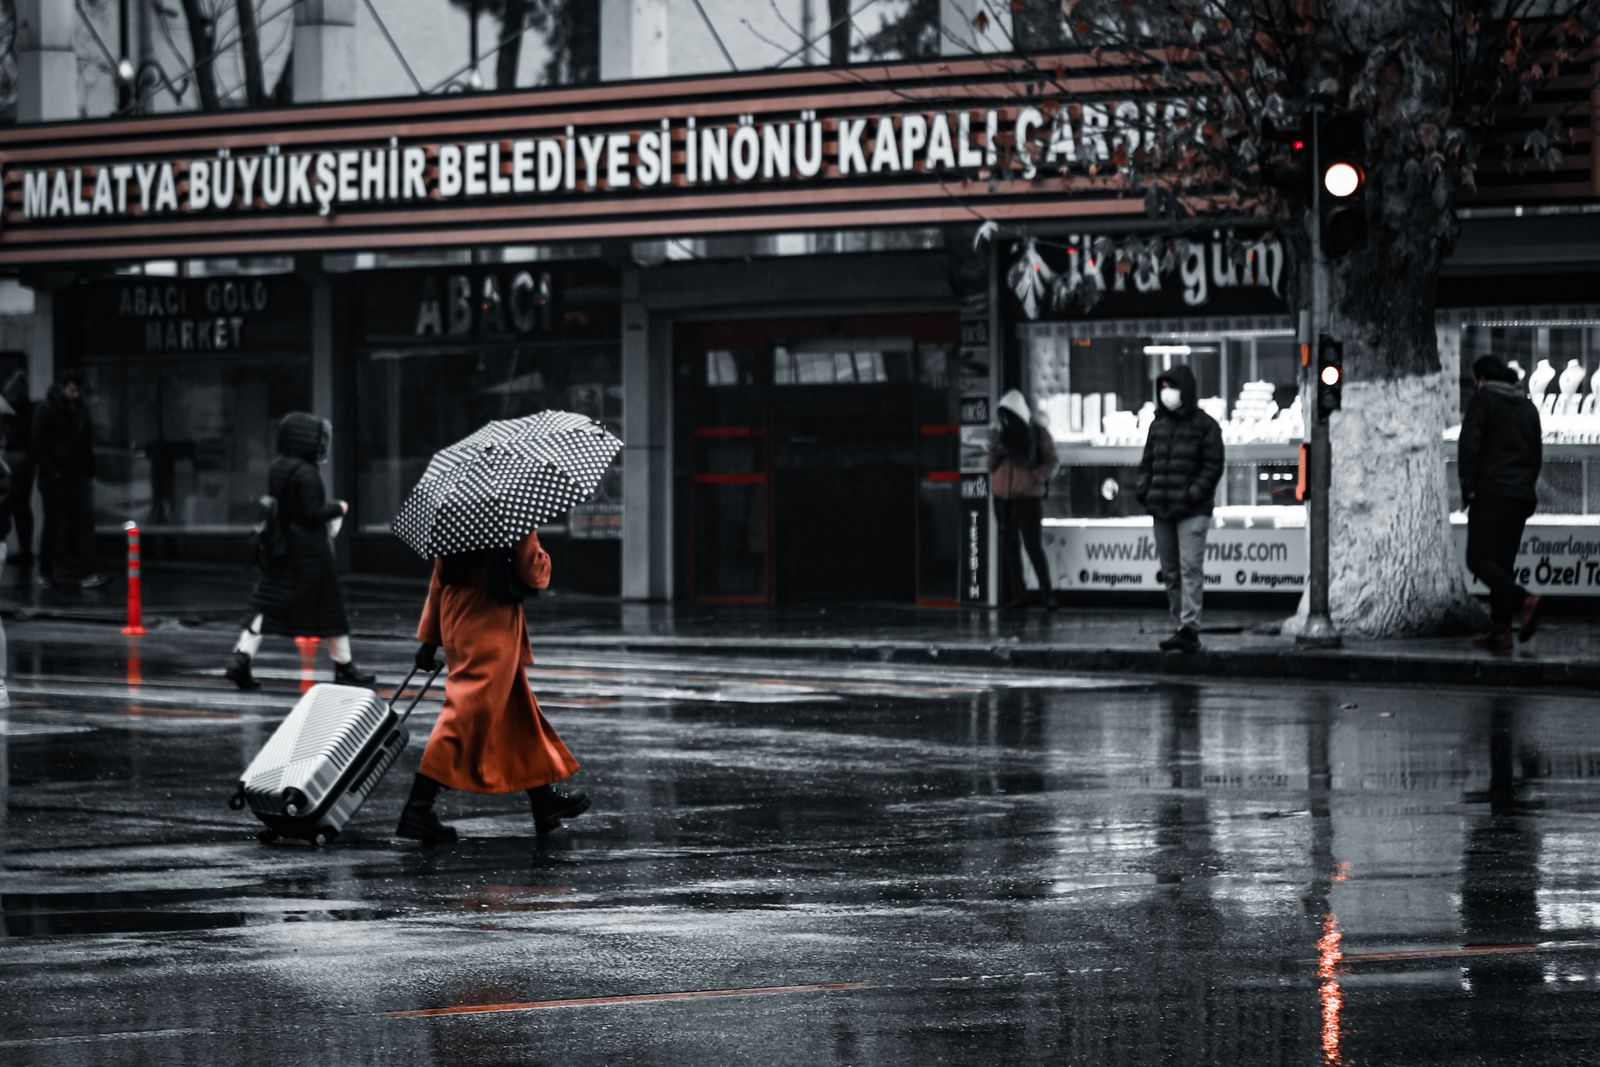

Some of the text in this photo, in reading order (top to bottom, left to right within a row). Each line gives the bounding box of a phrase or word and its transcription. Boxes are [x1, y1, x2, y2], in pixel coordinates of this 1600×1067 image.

[23, 162, 178, 218] MALATYA
[190, 136, 426, 216] BÜYÜKŞEHİR
[438, 117, 671, 197] BELEDİYESİ
[686, 110, 822, 183] İNÖNÜ
[838, 110, 997, 174] KAPALI
[118, 279, 268, 317] ABACI GOLD
[415, 271, 552, 336] ABACI
[145, 317, 243, 350] MARKET
[1086, 536, 1287, 562] www.ikmus.com
[1535, 557, 1581, 585] Özel
